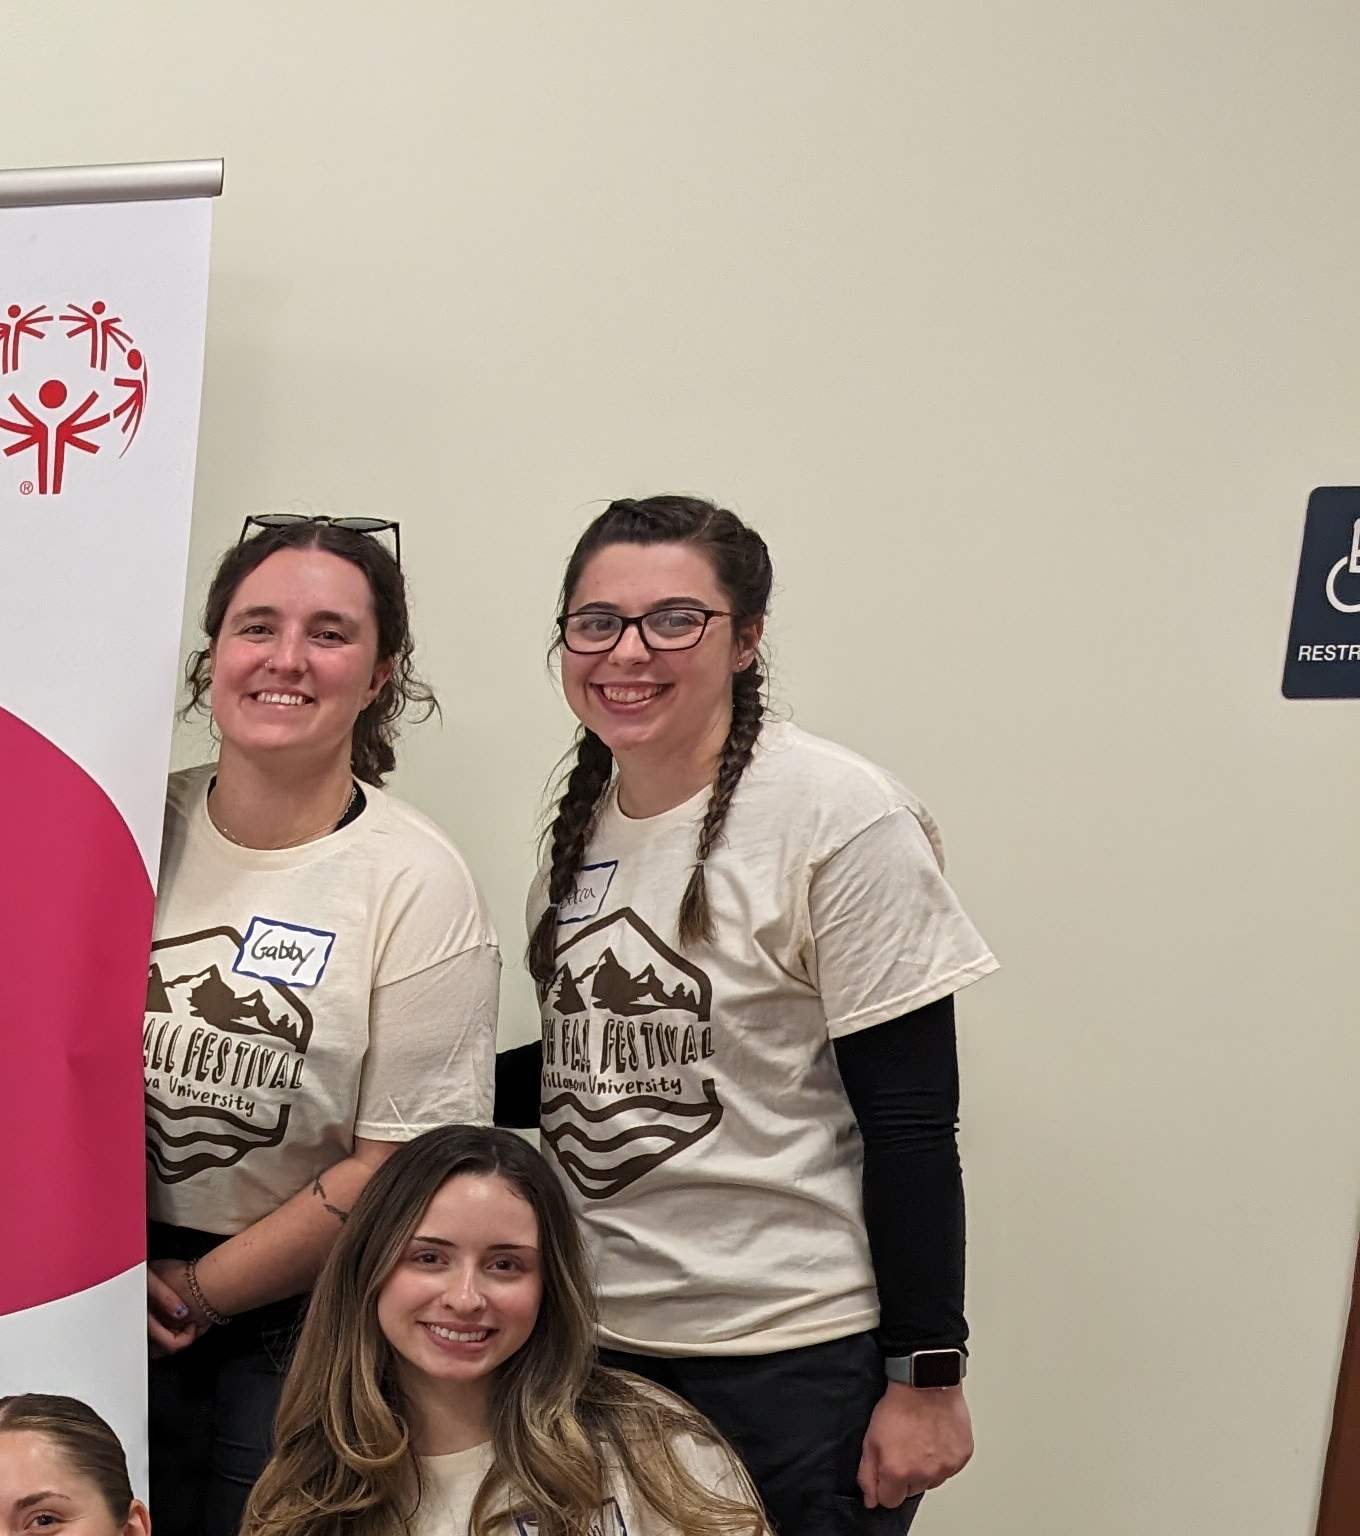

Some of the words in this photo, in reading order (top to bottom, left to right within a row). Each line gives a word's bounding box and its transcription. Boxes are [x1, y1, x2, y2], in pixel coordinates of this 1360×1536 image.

[250, 928, 316, 977] Gabby
[143, 1017, 183, 1074] ALL
[180, 1027, 305, 1091] FESTIVAL
[599, 1018, 716, 1075] FESTIVAL
[168, 1075, 256, 1118] University
[588, 1074, 682, 1096] University
